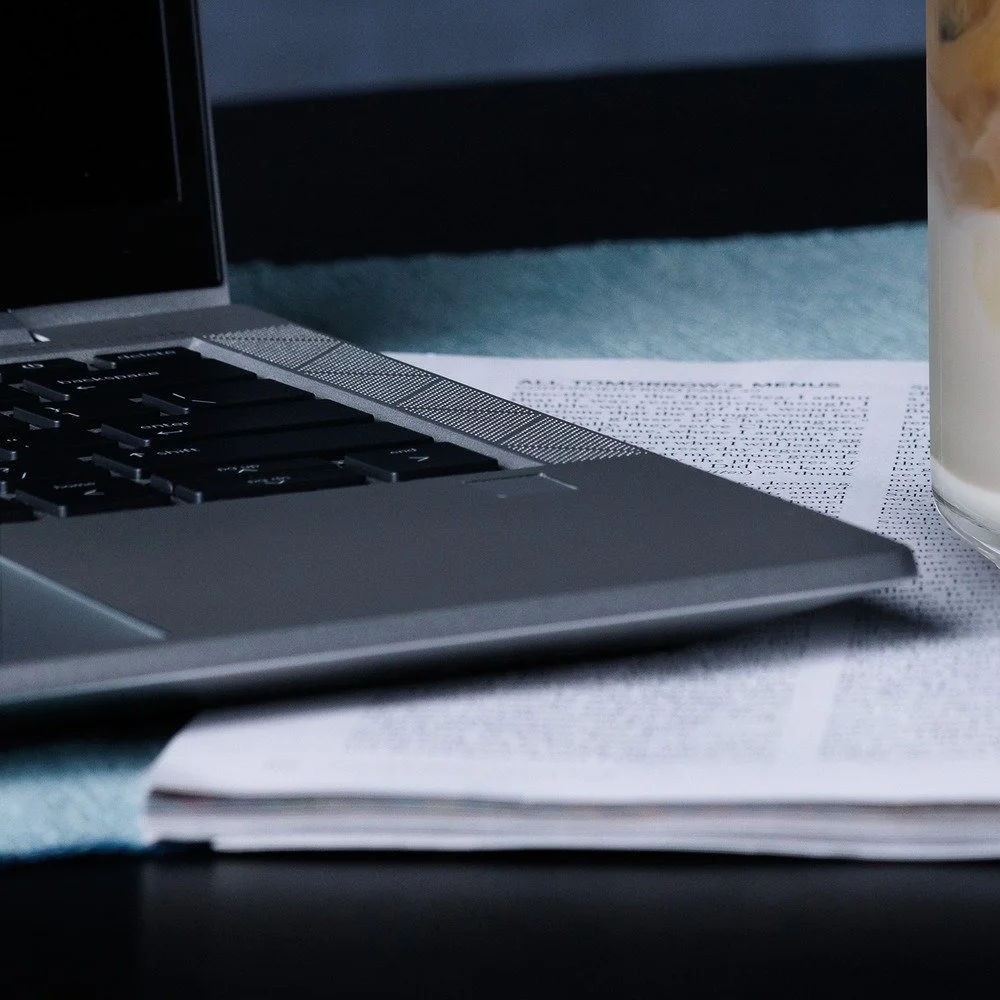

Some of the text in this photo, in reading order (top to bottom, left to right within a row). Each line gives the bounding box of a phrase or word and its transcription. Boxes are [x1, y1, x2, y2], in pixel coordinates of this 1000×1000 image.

[57, 371, 160, 385] backspace
[140, 420, 190, 430] enter
[156, 448, 199, 456] shift
